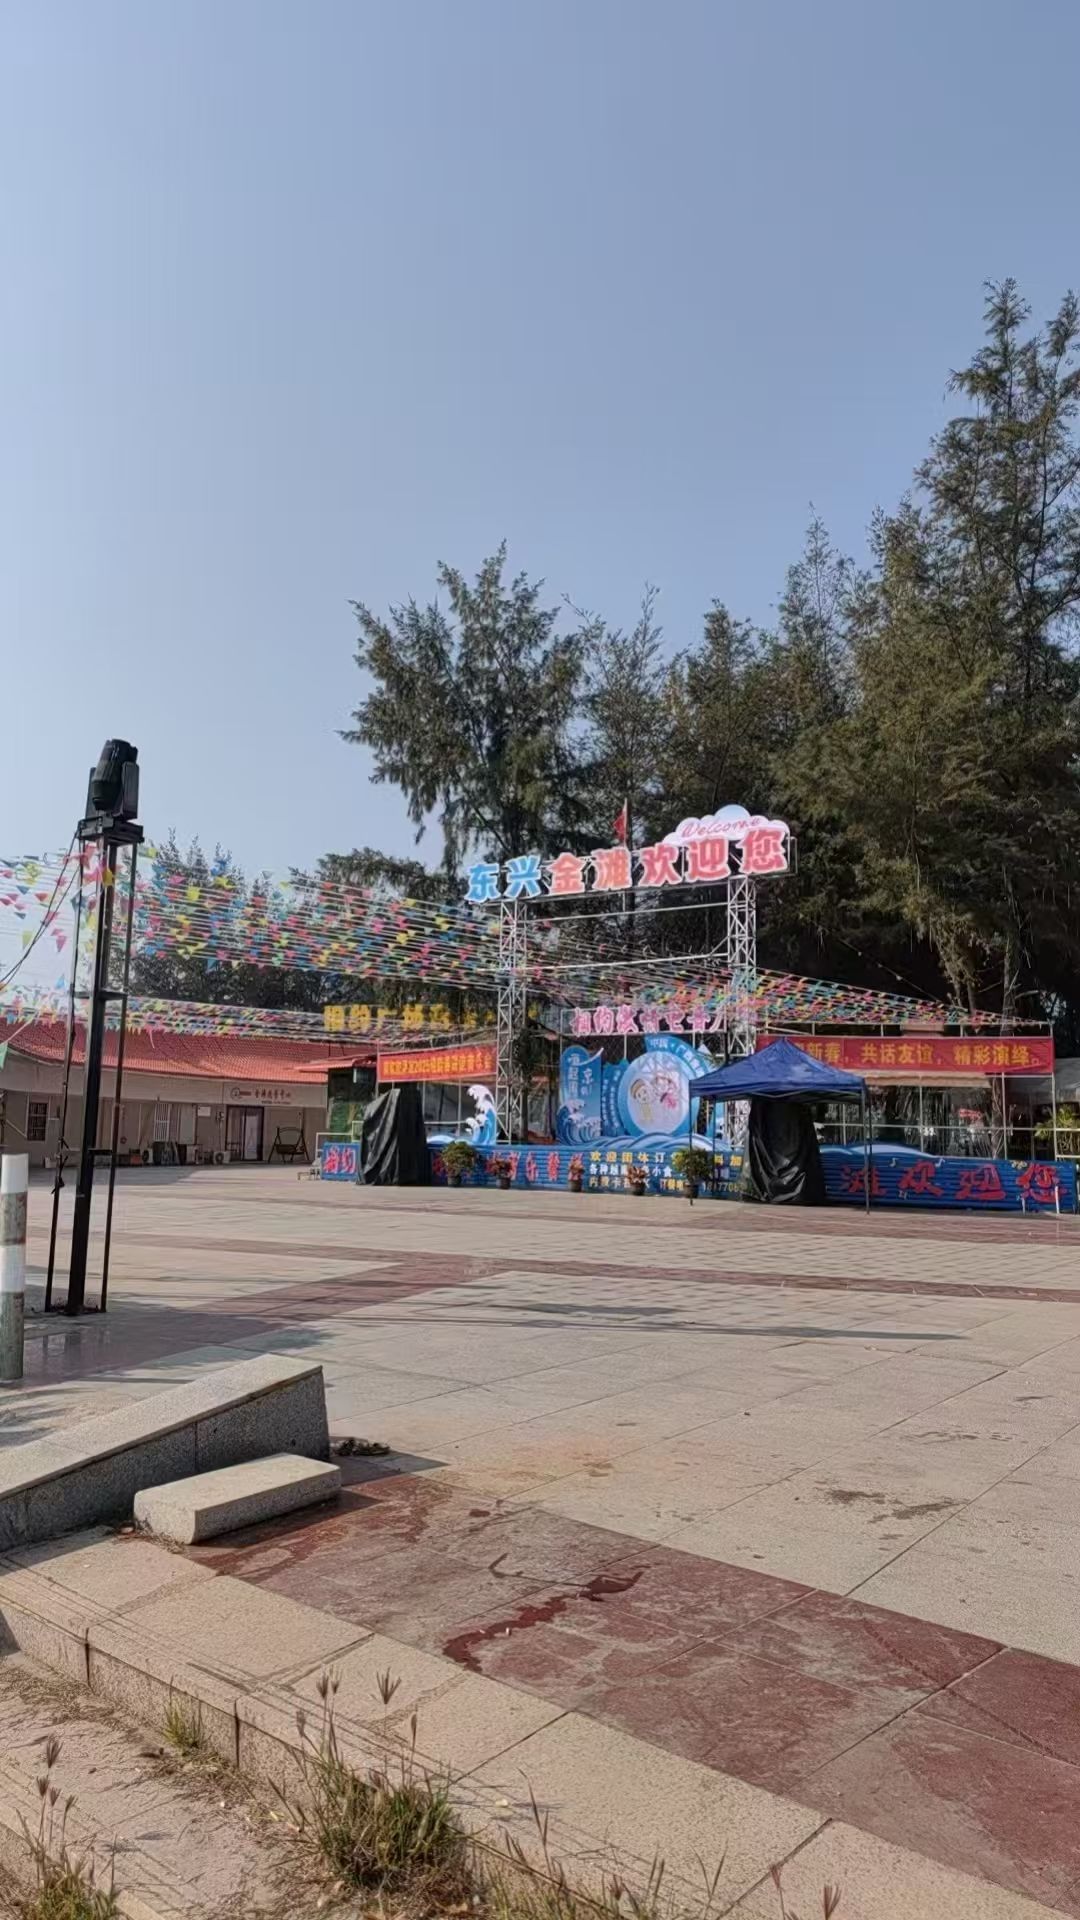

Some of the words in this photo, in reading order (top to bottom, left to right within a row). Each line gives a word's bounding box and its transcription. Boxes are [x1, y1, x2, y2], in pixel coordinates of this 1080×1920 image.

[681, 818, 760, 837] Welcome
[466, 829, 788, 901] 东兴金滩欢迎您
